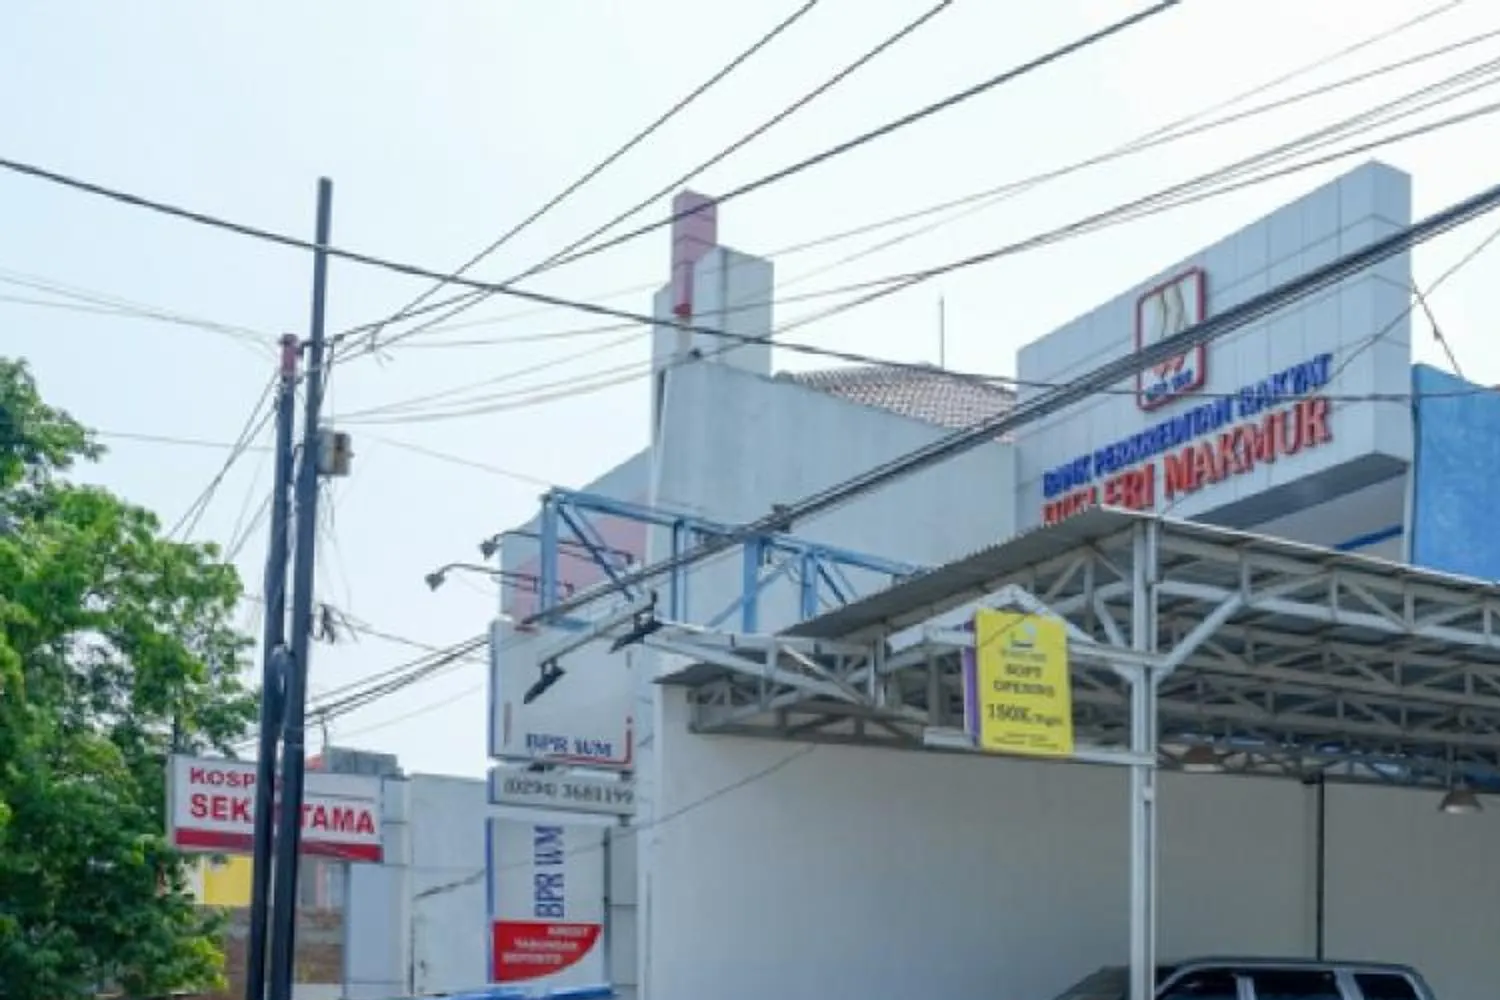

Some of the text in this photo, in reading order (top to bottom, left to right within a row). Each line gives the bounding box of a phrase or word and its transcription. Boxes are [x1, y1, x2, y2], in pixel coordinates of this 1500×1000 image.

[1043, 455, 1092, 498] BANK
[1239, 354, 1333, 416] RAKYAT
[1163, 397, 1333, 499] MAKMUR
[526, 733, 612, 757] BPR WM
[535, 826, 565, 917] BPR WM
